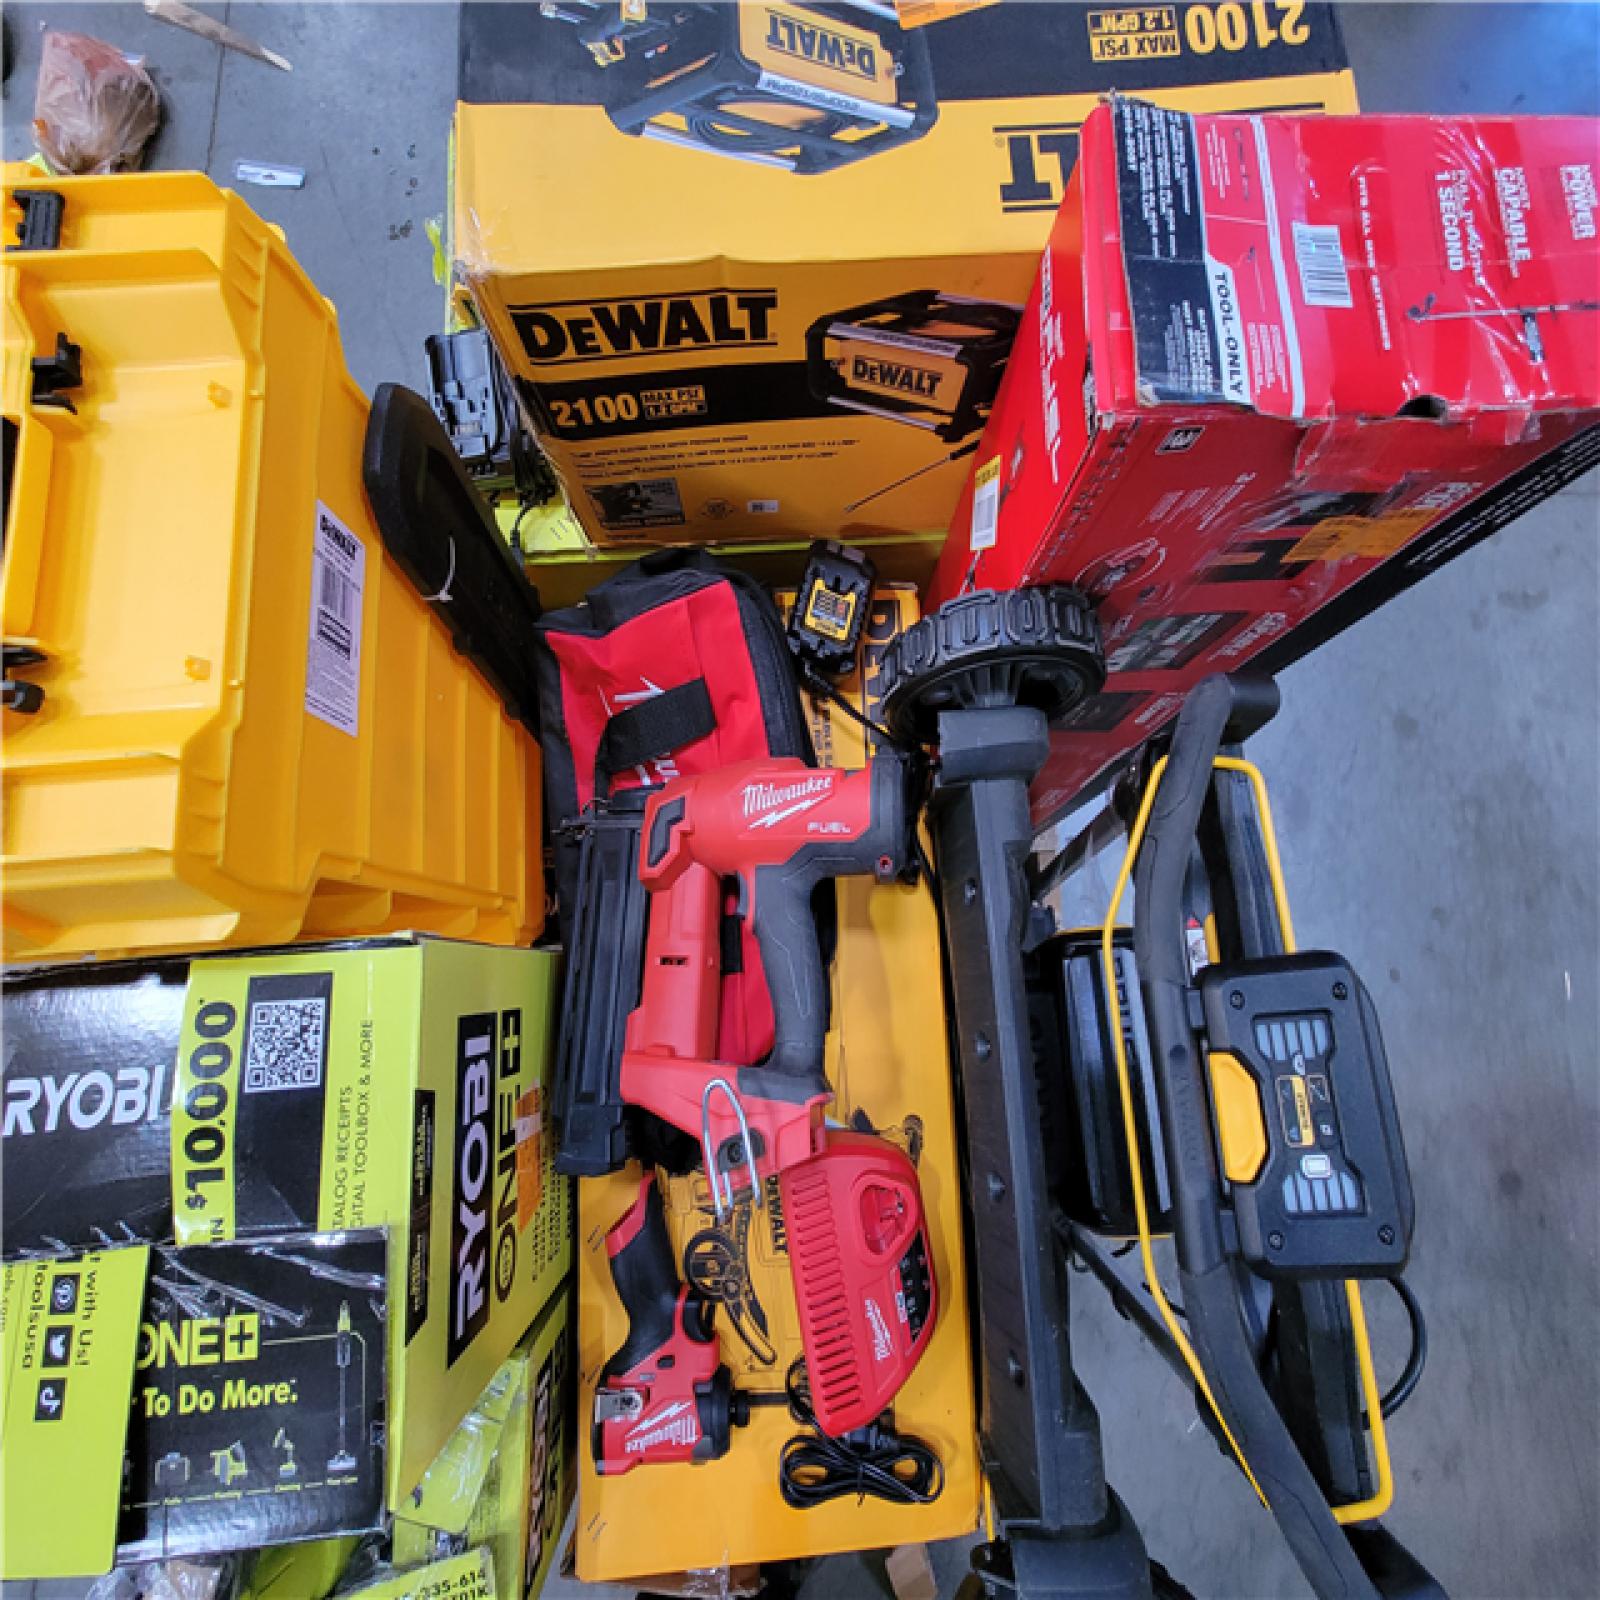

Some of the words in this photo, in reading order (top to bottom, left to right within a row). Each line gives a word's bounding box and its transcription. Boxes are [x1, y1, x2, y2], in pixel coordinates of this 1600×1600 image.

[1095, 38, 1130, 59] PSI
[1135, 34, 1177, 55] MAX
[1185, 0, 1310, 55] 2100
[1438, 187, 1465, 271] SECOND
[1215, 271, 1245, 395] TOOL-ONLY
[550, 394, 639, 427] 2100
[742, 775, 832, 817] Milwaukee
[807, 821, 852, 833] FUEL
[359, 1019, 373, 1070] MORE
[3, 1064, 166, 1137] RYOBI
[335, 1085, 352, 1163] RECEIPTS
[353, 1090, 371, 1176] TOOLBOX
[332, 1168, 348, 1230] TALOG
[455, 1032, 492, 1341] RYOBI
[82, 1269, 99, 1321] with
[75, 1328, 94, 1367] Us!
[142, 1386, 172, 1418] To
[177, 1383, 216, 1415] Do
[625, 1414, 698, 1454] Milwaukee
